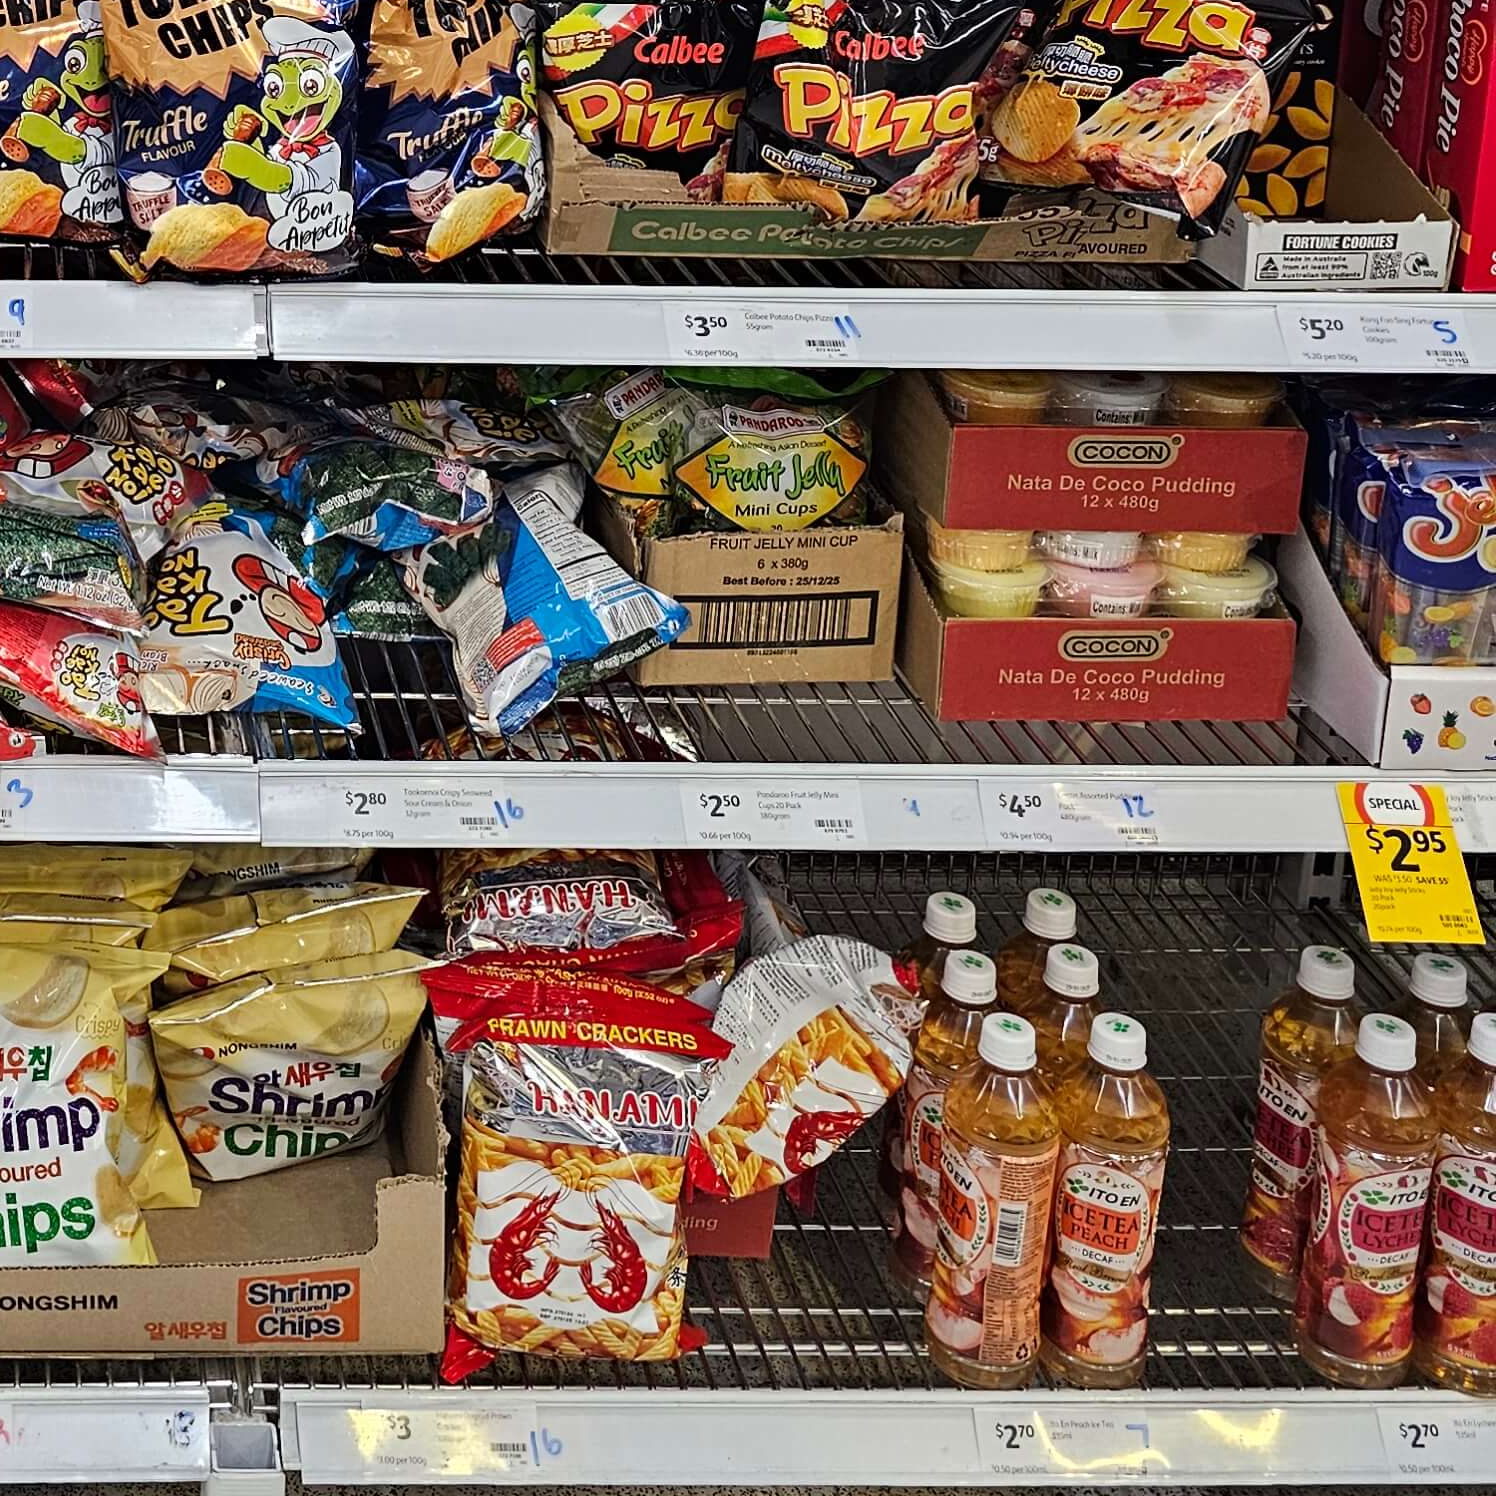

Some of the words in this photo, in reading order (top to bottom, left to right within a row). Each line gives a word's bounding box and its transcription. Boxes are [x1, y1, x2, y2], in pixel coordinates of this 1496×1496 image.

[634, 35, 724, 65] Calbee
[774, 62, 977, 159] Pizza
[122, 109, 208, 153] Truffle
[141, 140, 196, 162] FLAVOUR
[1286, 237, 1341, 248] FORTUNE
[1342, 235, 1395, 248] COOKIES
[1083, 445, 1164, 460] COCON
[706, 455, 786, 492] Fruit
[785, 450, 846, 500] Jelly
[1008, 475, 1053, 490] Nata
[1059, 475, 1085, 490] De
[1092, 476, 1144, 492] Coco
[1152, 477, 1236, 496] Pudding
[735, 503, 770, 517] Mini
[776, 503, 818, 517] Cups
[1081, 496, 1099, 508] 12
[1104, 498, 1114, 508] x
[1119, 496, 1159, 511] 480g
[710, 538, 752, 550] FRUIT
[754, 538, 794, 549] JELLY
[797, 537, 826, 548] MINI
[830, 536, 858, 547] CUP
[723, 576, 748, 586] Best
[751, 576, 787, 586] Before
[796, 576, 840, 586] 25/12/25
[1368, 798, 1420, 811] SPECIAL
[487, 1018, 567, 1041] PRAWN
[576, 1021, 699, 1051] CRACKERS
[1089, 1187, 1119, 1204] ITO
[1120, 1194, 1141, 1207] EN
[1098, 1213, 1138, 1234] TEA
[1071, 1222, 1128, 1249] PEACH
[247, 1280, 351, 1306] Shrimp
[257, 1314, 341, 1340] Chips
